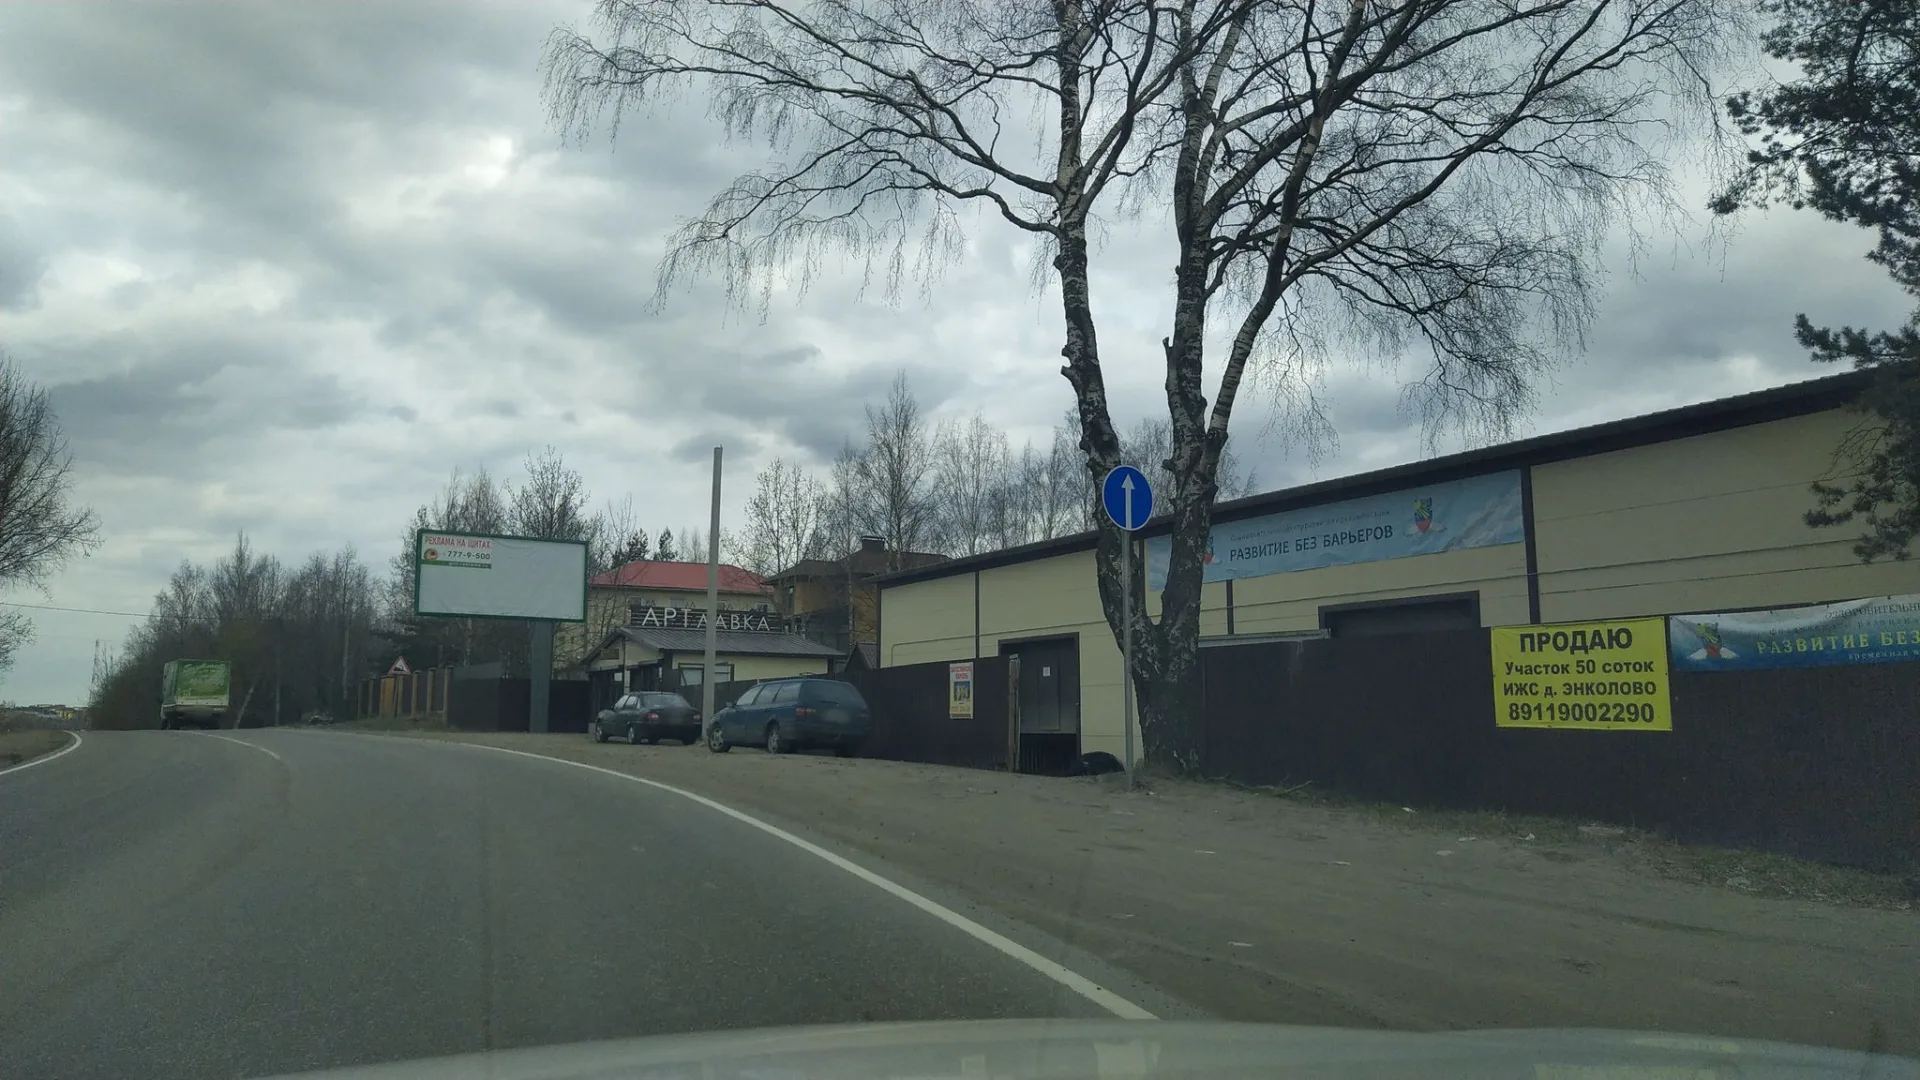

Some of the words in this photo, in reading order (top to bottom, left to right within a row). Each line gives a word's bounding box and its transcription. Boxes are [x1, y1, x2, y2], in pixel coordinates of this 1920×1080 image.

[425, 536, 455, 548] РЕКЛАМА
[458, 539, 466, 548] НА
[468, 540, 490, 550] ЩИТАХ
[1230, 541, 1289, 561] РАЗВИТИЕ
[1296, 536, 1317, 552] БЕЗ
[1323, 525, 1393, 547] БАРЬЕРОВ
[447, 550, 491, 560] 777-9-500
[1520, 628, 1633, 655] ПРОДАЮ
[1756, 633, 1869, 655] РАЗВИТИЕ
[1880, 630, 1920, 647] БЕЗ
[1505, 661, 1570, 675] Участок
[1575, 660, 1596, 674] 50
[1602, 660, 1654, 674] соток
[1503, 682, 1539, 696] ИЖС
[1544, 685, 1557, 698] д.
[1562, 681, 1657, 696] ЭНКОЛОВО
[1508, 702, 1655, 723] 89119002290
